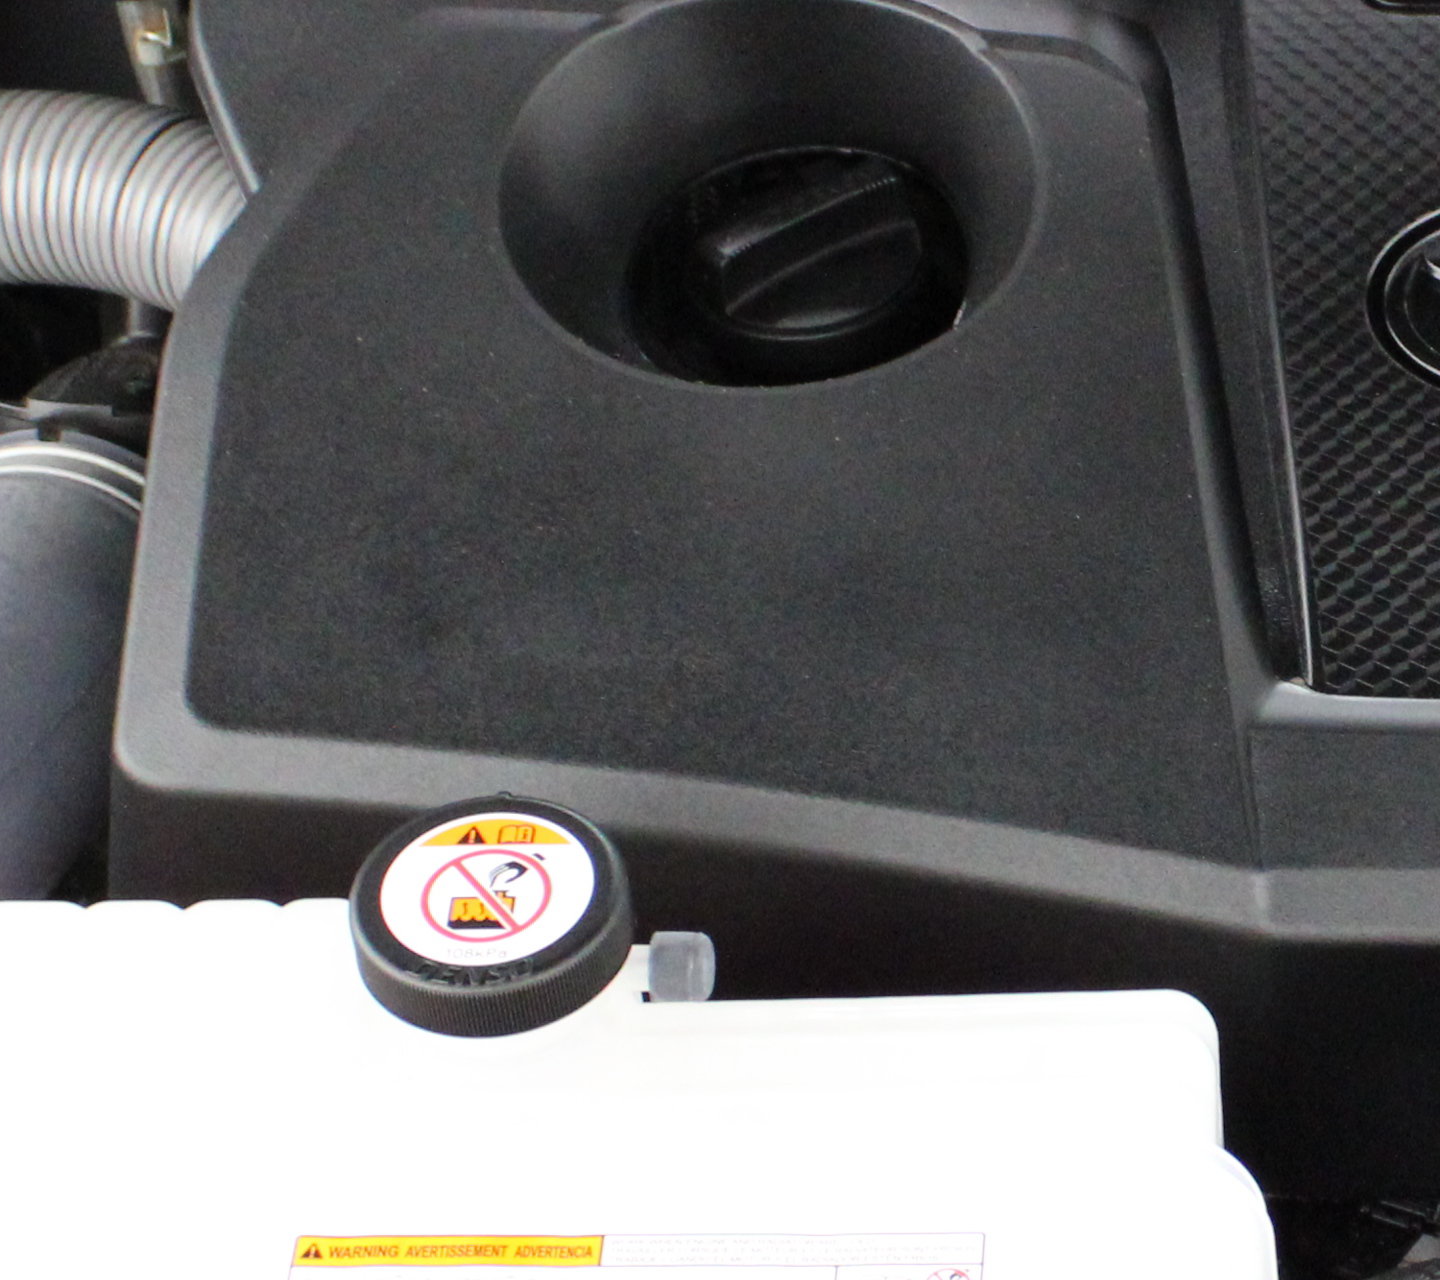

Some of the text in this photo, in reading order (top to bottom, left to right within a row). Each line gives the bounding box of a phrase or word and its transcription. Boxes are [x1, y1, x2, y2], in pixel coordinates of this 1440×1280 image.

[328, 1243, 401, 1259] WARNING
[405, 1243, 509, 1260] AVERTISSEMENT
[514, 1244, 595, 1260] ADVERTENCIA
